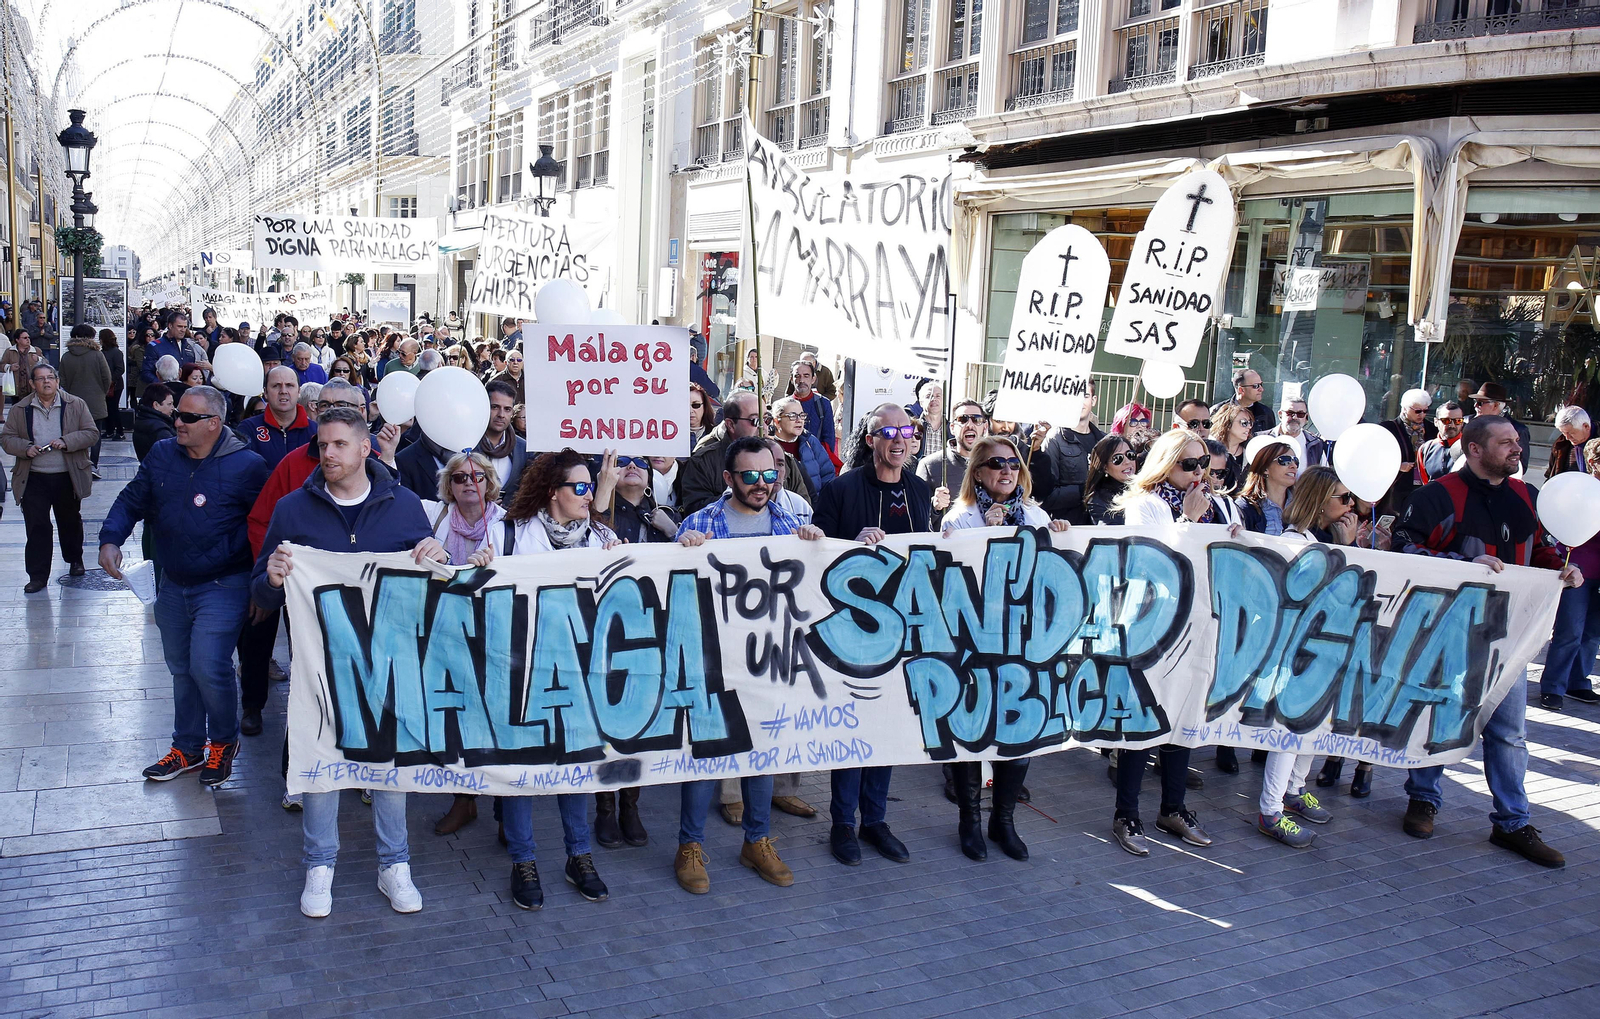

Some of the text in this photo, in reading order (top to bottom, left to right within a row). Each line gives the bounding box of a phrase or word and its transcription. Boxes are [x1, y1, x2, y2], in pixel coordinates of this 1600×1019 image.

[303, 219, 335, 235] UNA
[329, 239, 366, 258] PARA
[242, 297, 252, 305] LA
[256, 297, 271, 306] QUE
[278, 293, 298, 305] MÁS
[899, 244, 949, 340] YA
[1029, 289, 1084, 320] R.I.P.
[233, 309, 250, 320] UNA
[1124, 320, 1179, 351] SAS
[547, 333, 673, 372] Málaga
[566, 376, 669, 406] por su
[1002, 368, 1088, 397] MALAGUEÑA
[256, 426, 270, 442] 3
[560, 418, 679, 440] SANIDAD
[707, 546, 812, 624] POR
[313, 566, 753, 767] MÁLAGA
[745, 610, 828, 699] UNA
[759, 702, 859, 740] #VAMOS
[1182, 724, 1208, 742] #NO
[1214, 724, 1223, 739] A
[1227, 724, 1242, 742] LA
[650, 753, 741, 776] #MARCHA
[748, 746, 779, 772] POR
[785, 743, 801, 765] LA
[299, 760, 489, 791] #TERCER HOSPITAL
